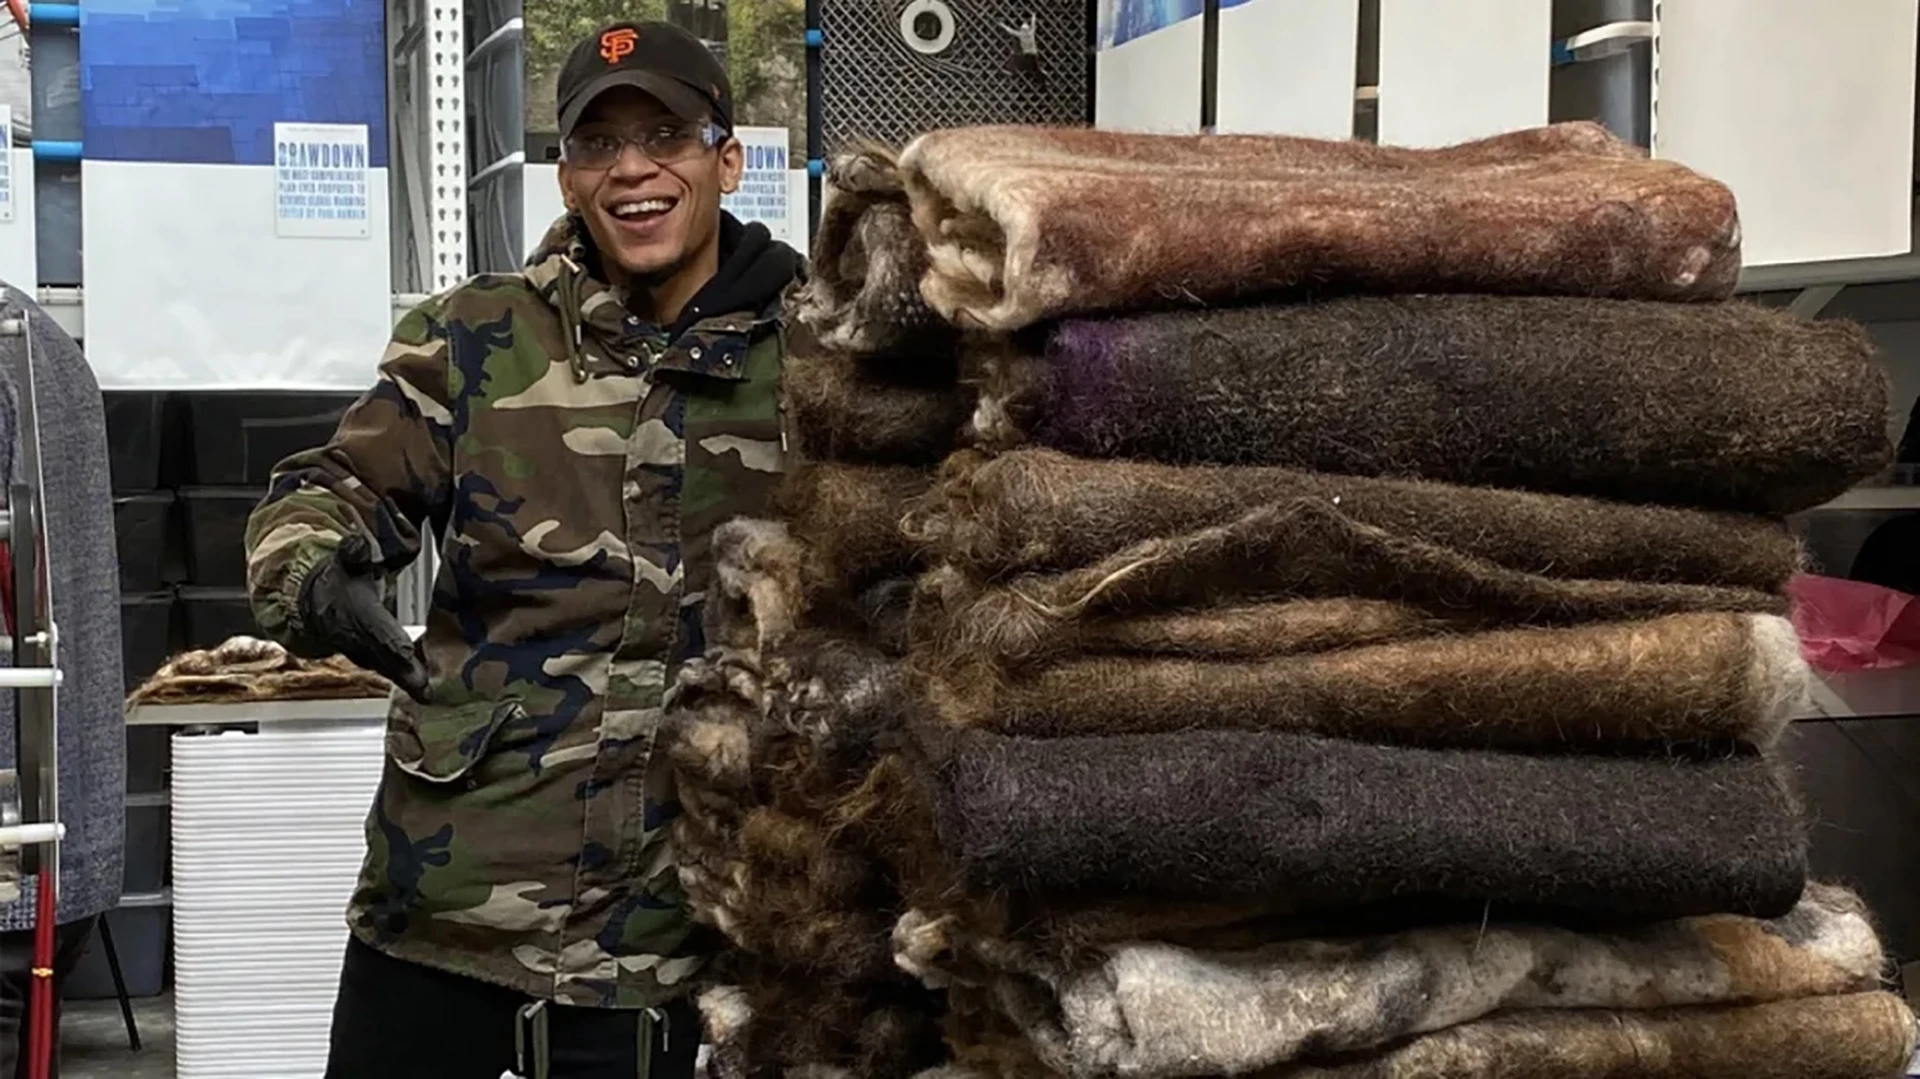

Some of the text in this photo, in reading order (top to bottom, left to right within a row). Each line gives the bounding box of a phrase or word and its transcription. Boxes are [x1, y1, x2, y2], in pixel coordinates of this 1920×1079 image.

[600, 28, 640, 64] SF
[278, 141, 365, 168] DRAWDOWN
[745, 145, 785, 169] DOWN
